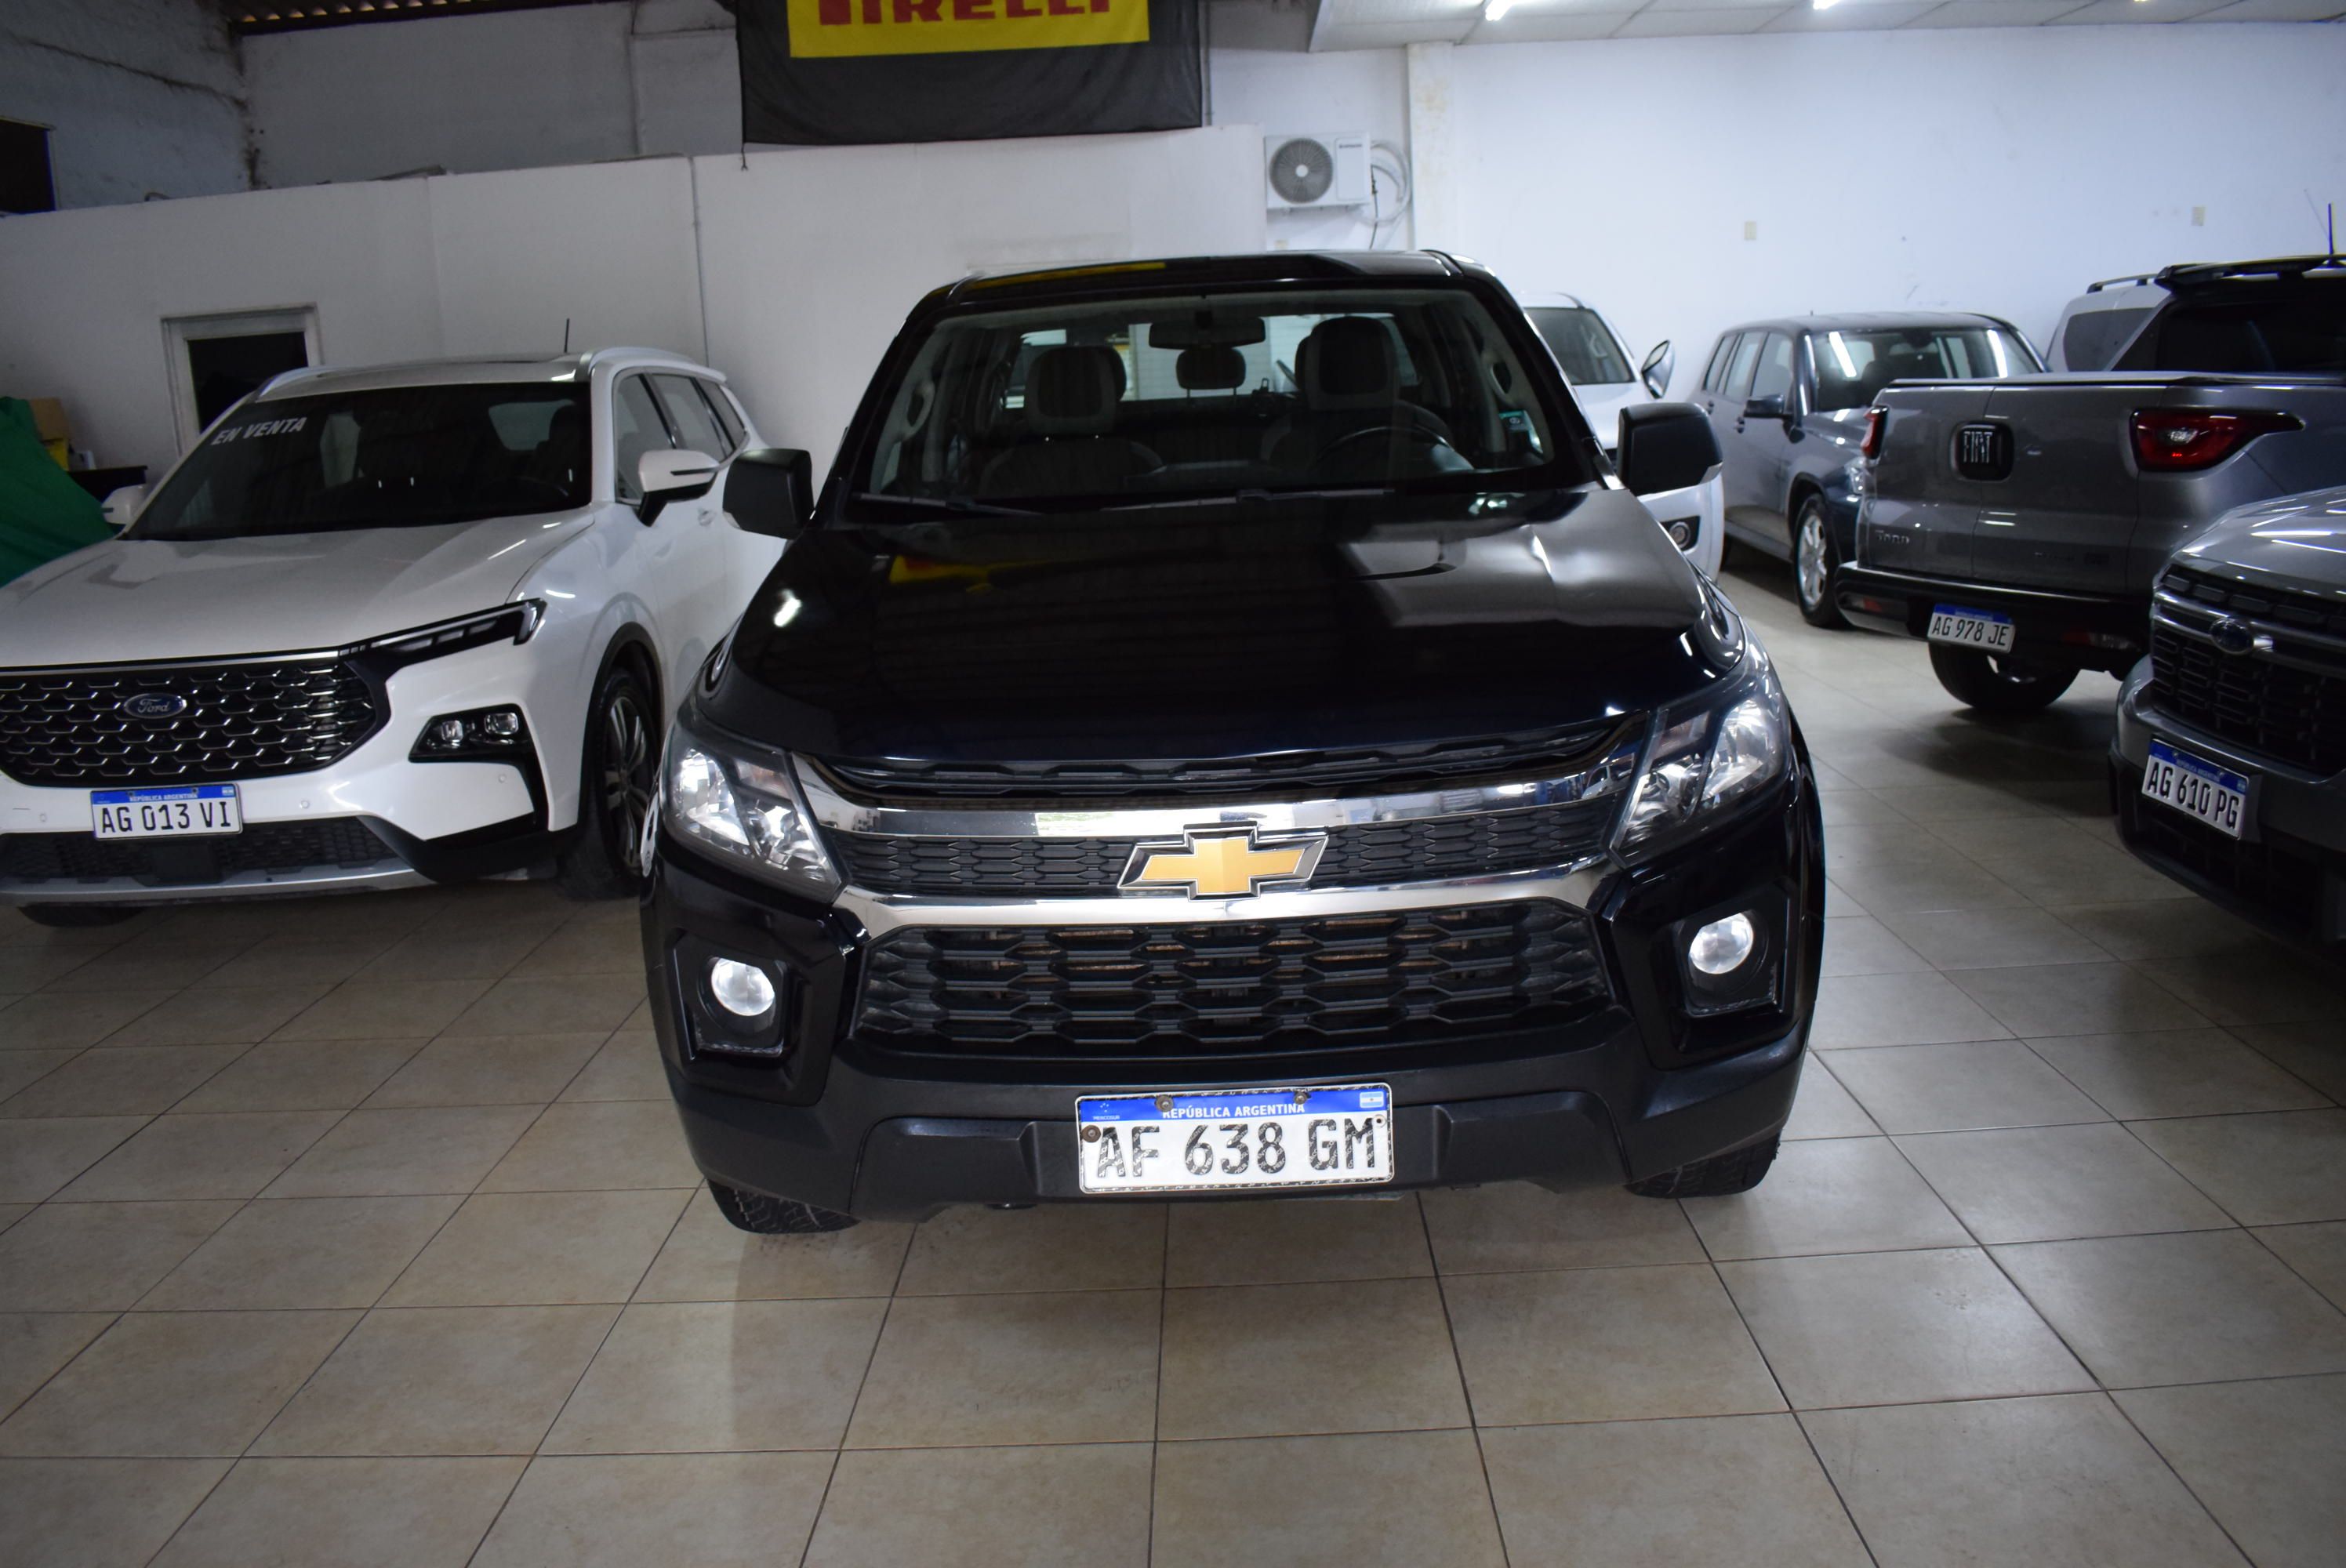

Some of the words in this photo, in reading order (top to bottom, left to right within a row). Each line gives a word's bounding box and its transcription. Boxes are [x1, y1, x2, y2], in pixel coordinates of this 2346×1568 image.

[210, 426, 242, 445] EN
[243, 417, 307, 439] VENTA
[1963, 431, 1992, 463] FIAT
[1932, 616, 1952, 636] AG
[1956, 619, 1985, 641] 978
[1988, 624, 2010, 646] JE
[138, 699, 170, 713] Ford
[2147, 762, 2174, 798] AG
[2177, 775, 2211, 815] 610
[2214, 789, 2239, 829] PG
[102, 806, 133, 833] AG
[141, 804, 190, 831] 013
[200, 801, 231, 828] VI
[1163, 1105, 1231, 1119] REPÚBLICA
[1234, 1102, 1306, 1116] ARGENTINA
[1098, 1125, 1160, 1178] AF
[1185, 1122, 1286, 1175] 638
[1308, 1117, 1375, 1171] GM
